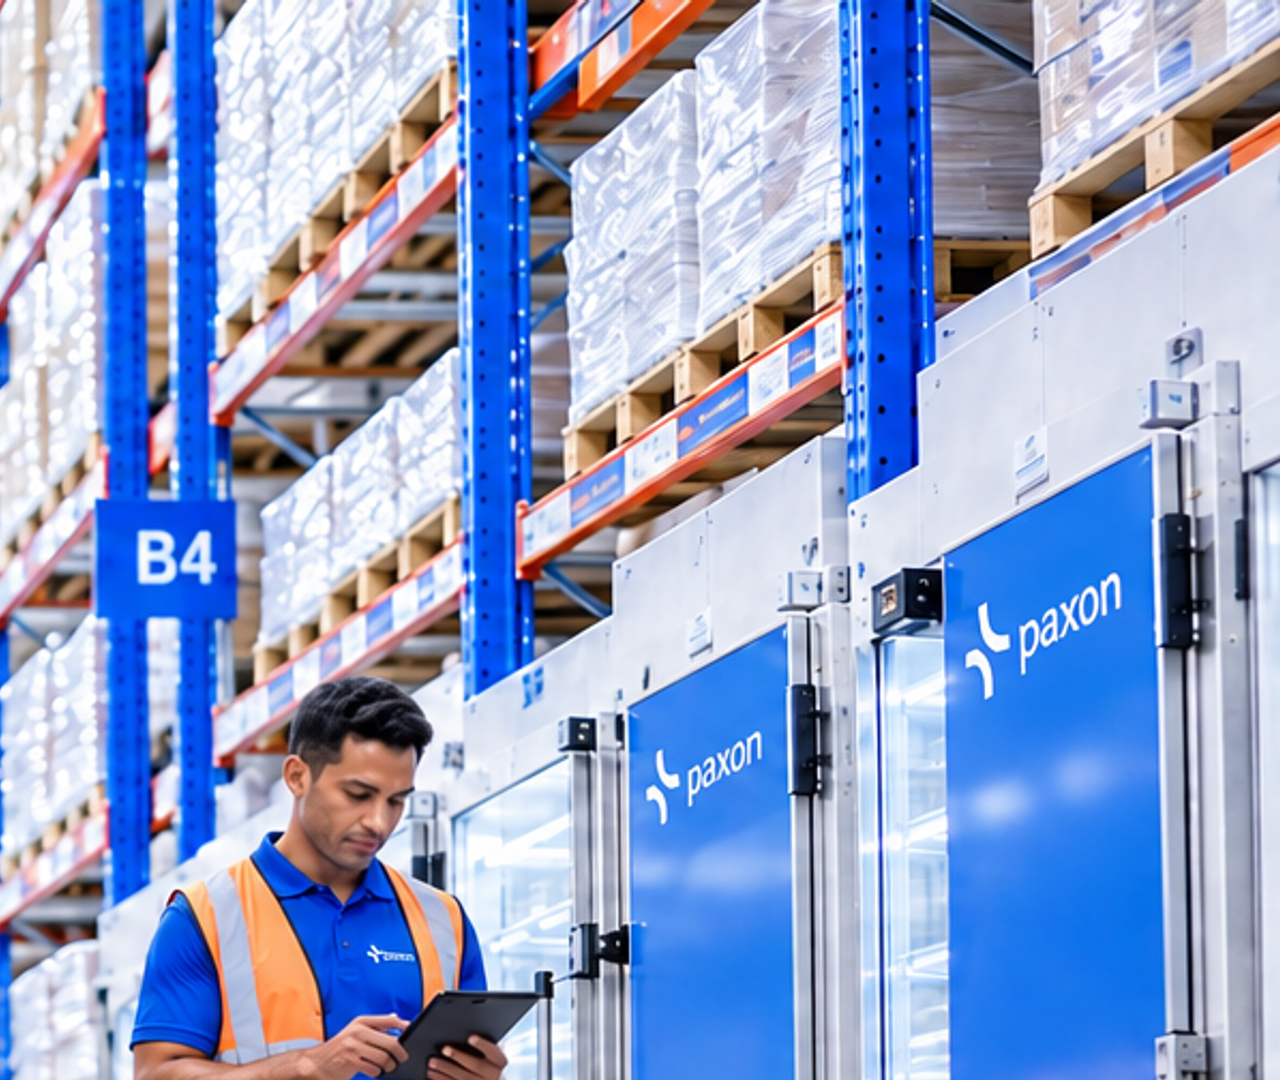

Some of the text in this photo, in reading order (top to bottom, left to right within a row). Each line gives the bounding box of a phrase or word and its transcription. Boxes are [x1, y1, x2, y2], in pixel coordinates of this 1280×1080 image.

[137, 530, 217, 584] B4
[1018, 572, 1122, 676] paxon
[687, 730, 763, 807] paxon
